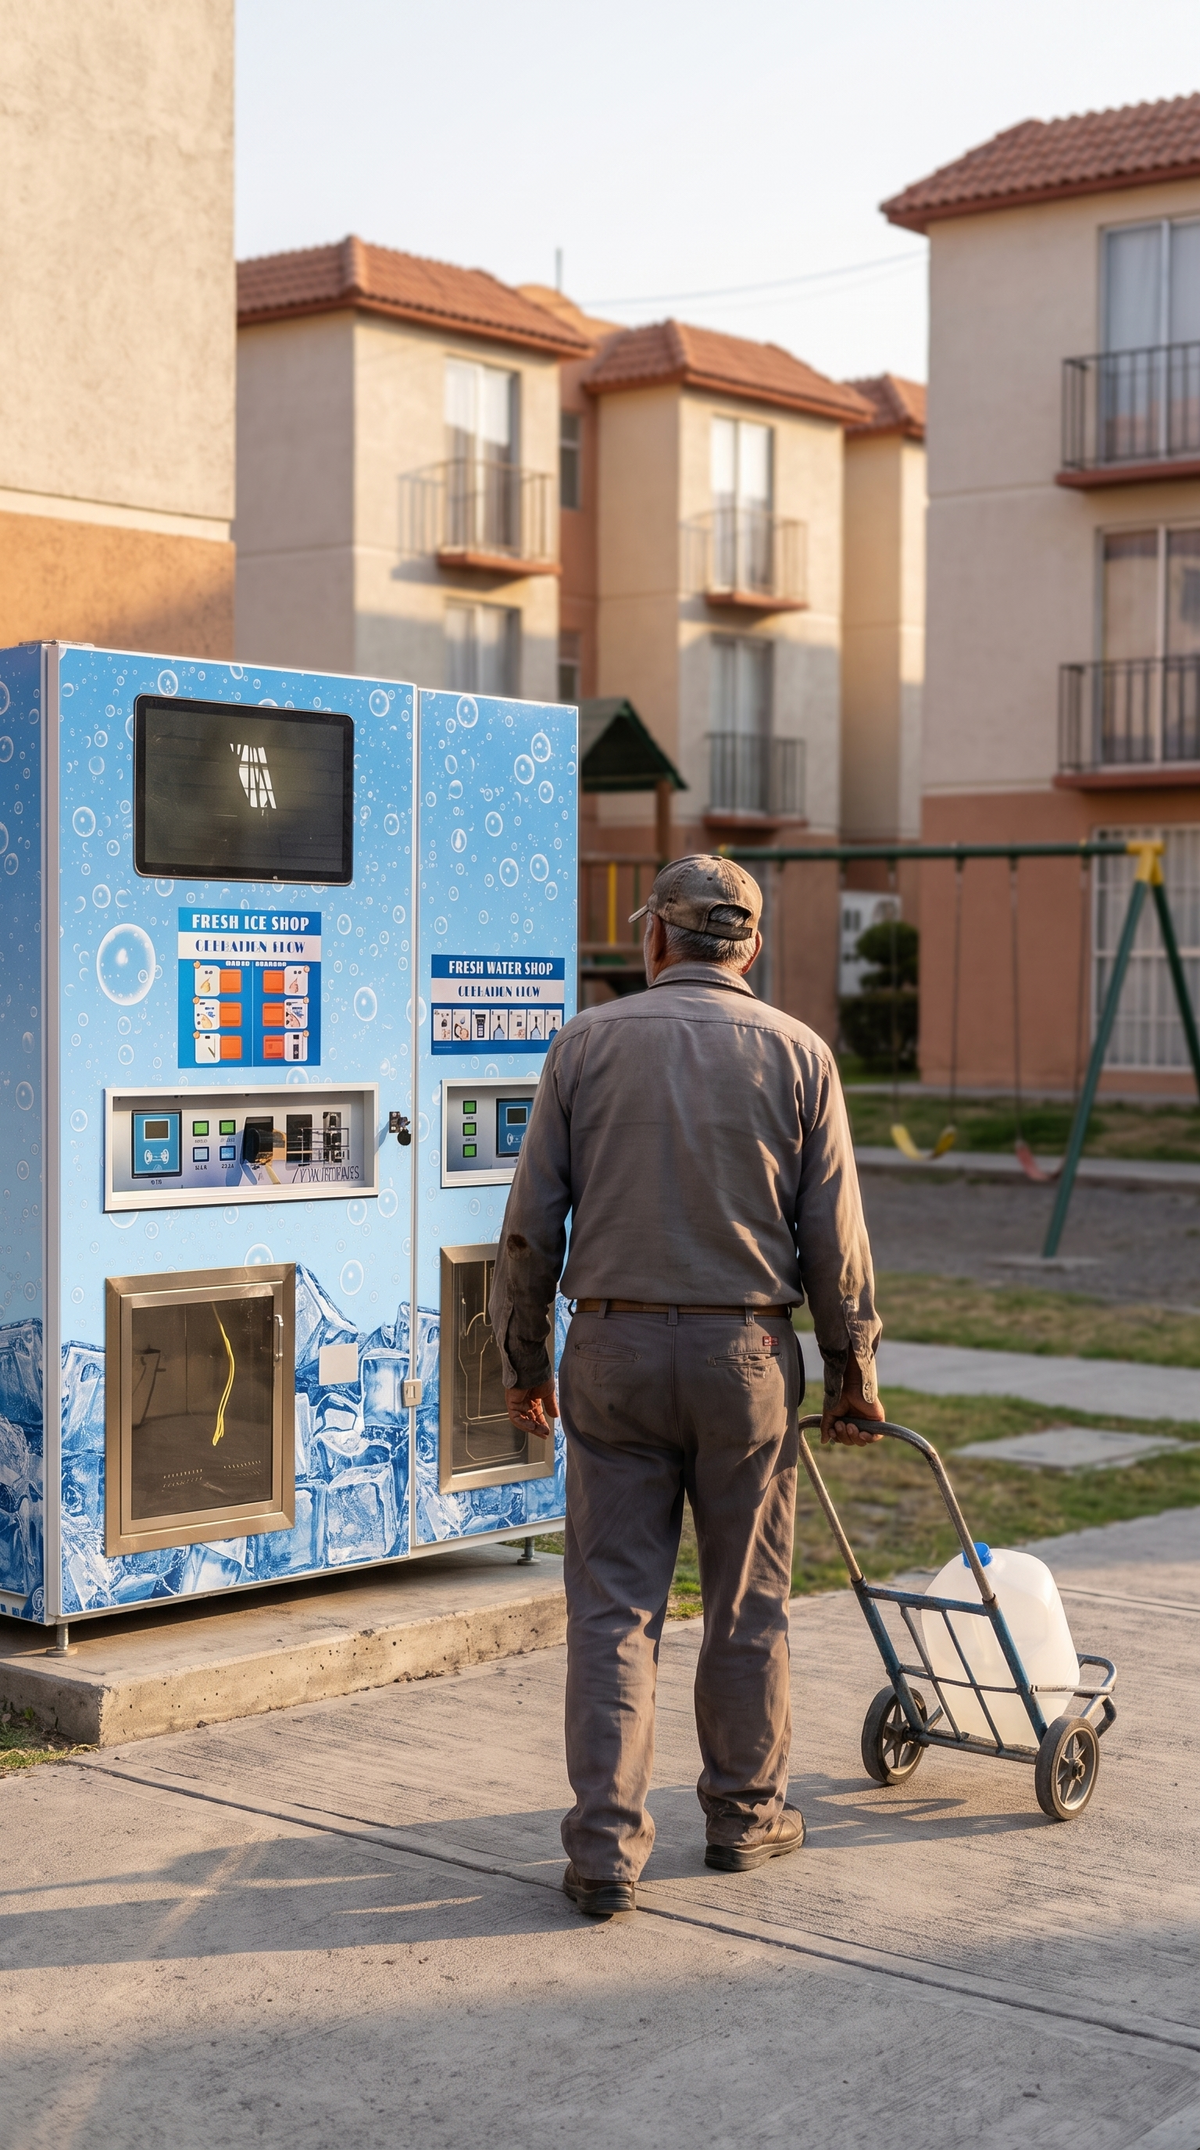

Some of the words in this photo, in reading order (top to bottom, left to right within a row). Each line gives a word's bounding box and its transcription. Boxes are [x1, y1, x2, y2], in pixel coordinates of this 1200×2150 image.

[192, 914, 239, 929] FRESH
[244, 915, 267, 930] ICE
[271, 916, 309, 931] SHOP
[449, 960, 484, 974] FRESH
[486, 961, 522, 975] WATER
[524, 962, 553, 975] SHOP
